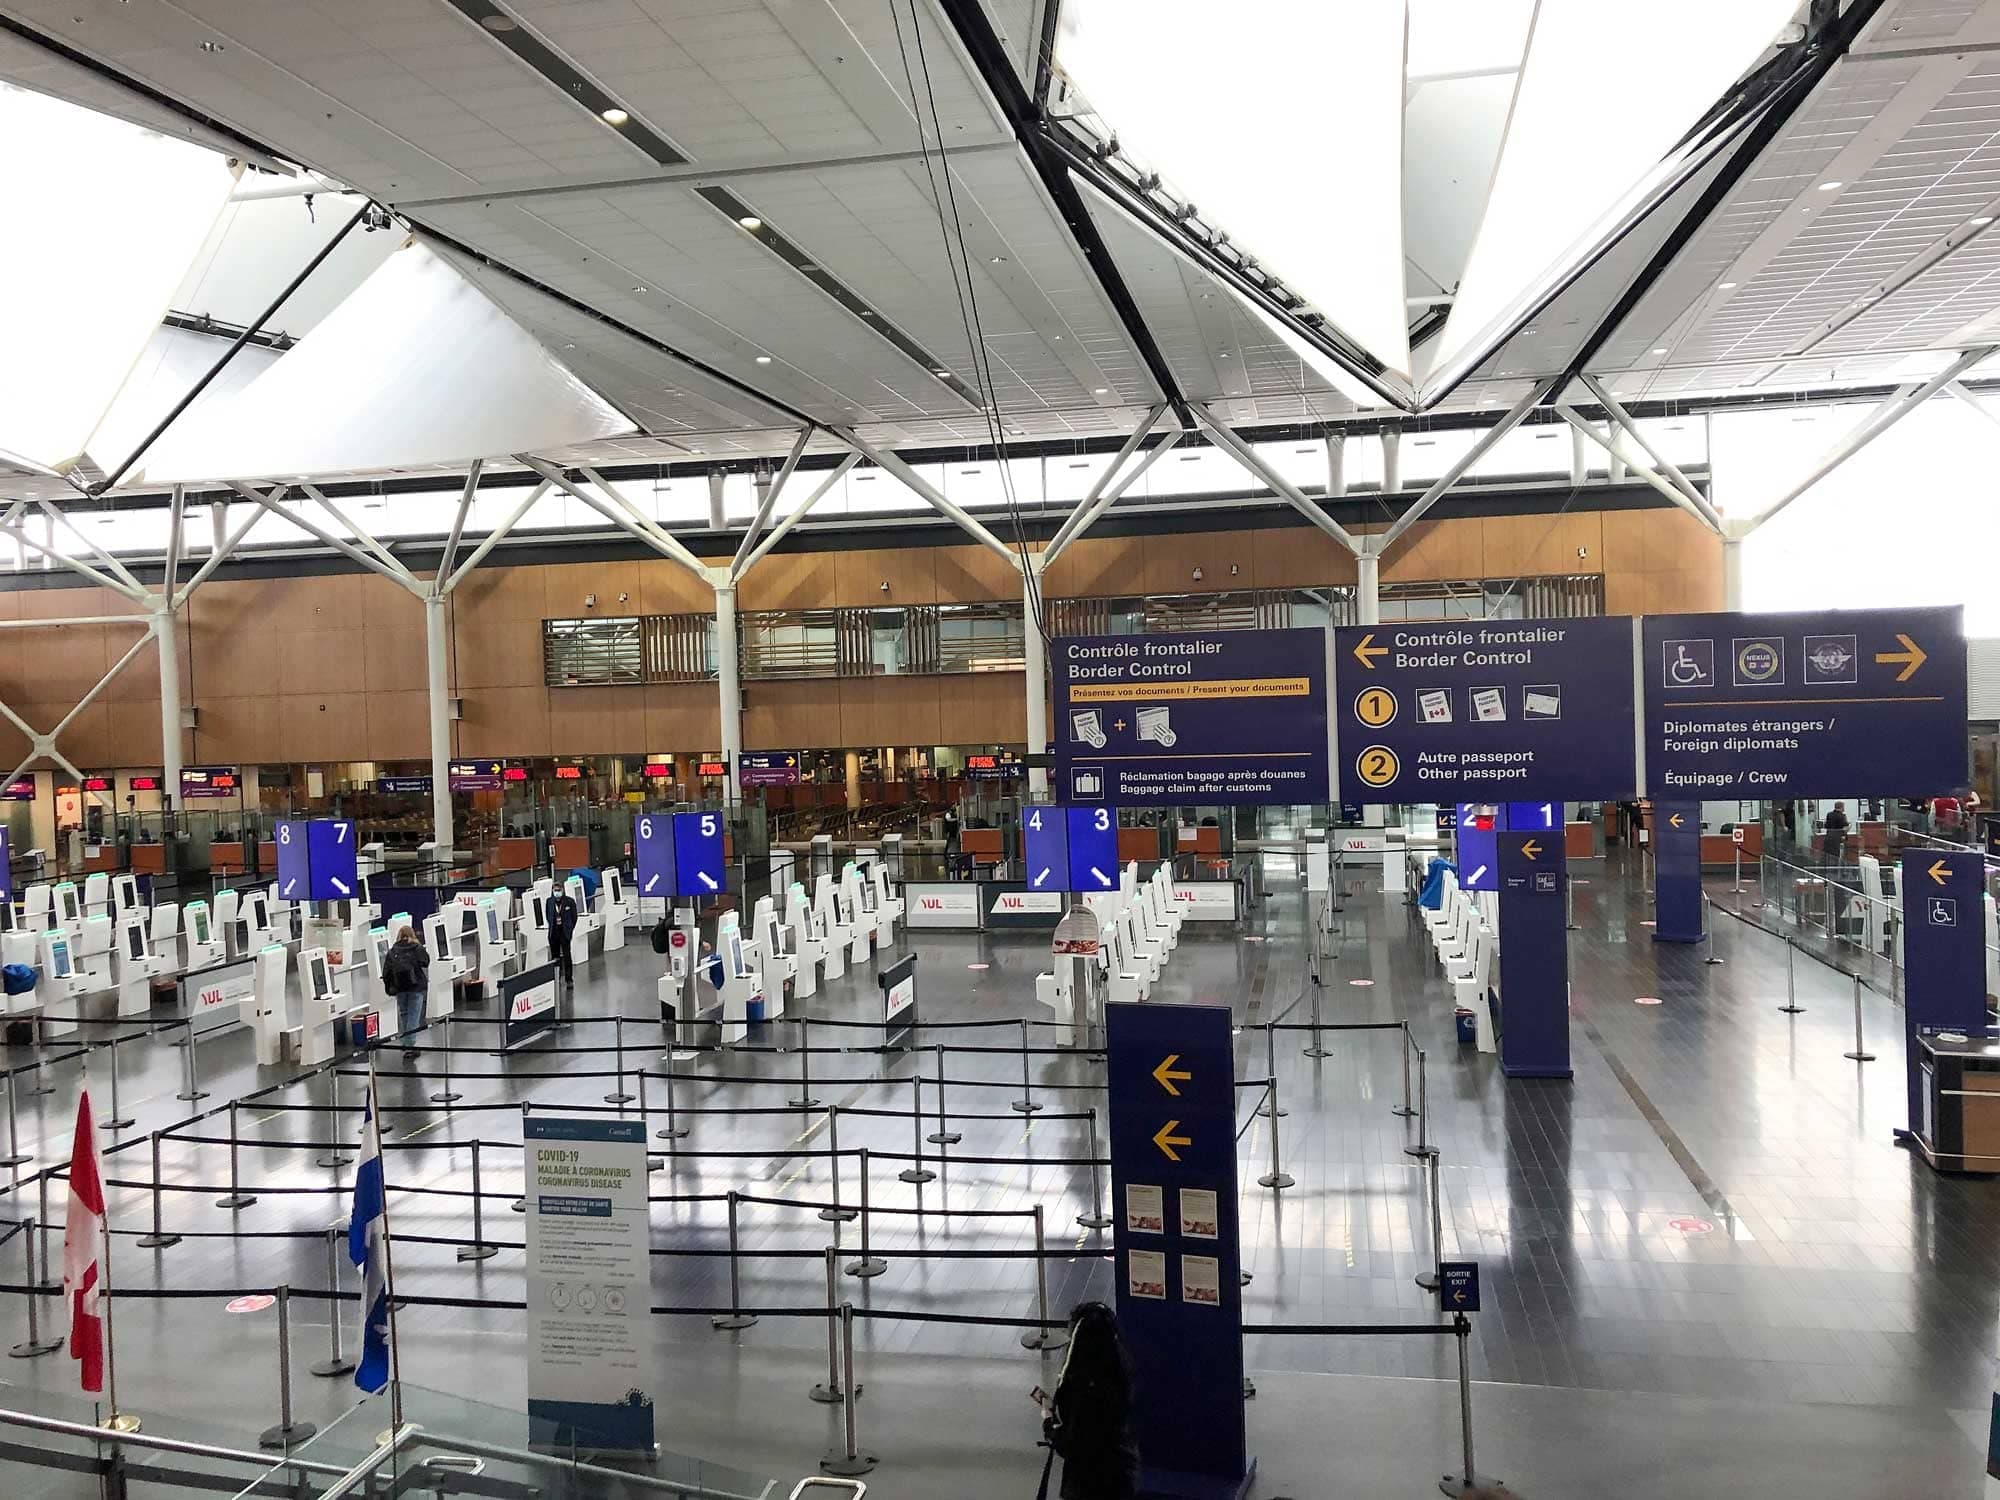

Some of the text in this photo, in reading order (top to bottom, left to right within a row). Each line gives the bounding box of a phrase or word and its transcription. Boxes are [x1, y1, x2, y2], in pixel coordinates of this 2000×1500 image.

[1395, 628, 1565, 647] Contrôle frontalier
[1068, 640, 1223, 659] Contrôle frontalier
[1396, 649, 1532, 668] Border Control
[1069, 661, 1192, 679] Border Control
[1136, 687, 1185, 696] documents
[1193, 685, 1227, 694] Present
[1230, 686, 1250, 694] your
[1252, 683, 1304, 692] documents
[1369, 695, 1380, 717] 1
[1664, 718, 1836, 735] Diplomates étrangers /
[1664, 737, 1799, 753] Foreign diplomats
[1370, 755, 1387, 776] 2
[1417, 751, 1534, 764] Autre passeport
[1120, 770, 1306, 782] Réclamation bagage après douanes
[1418, 767, 1527, 780] Other passport
[1665, 769, 1788, 786] Équipage / Crew
[1120, 783, 1272, 795] Baggage claim after customs
[1029, 809, 1043, 831] 4
[1094, 808, 1110, 831] 3
[1540, 803, 1552, 827] 1
[280, 824, 290, 844] 8
[333, 823, 348, 844] 7
[640, 818, 652, 839] 6
[701, 815, 716, 836] 5
[921, 899, 943, 909] YUL
[1002, 897, 1025, 908] YUL
[201, 989, 223, 1006] YUL
[516, 997, 532, 1014] YUL
[538, 1149, 579, 1162] COVID-19
[537, 1165, 570, 1175] MALADIE
[579, 1166, 631, 1178] CORONAVIRUS
[537, 1176, 622, 1189] CORONAVIRUS DISEASE
